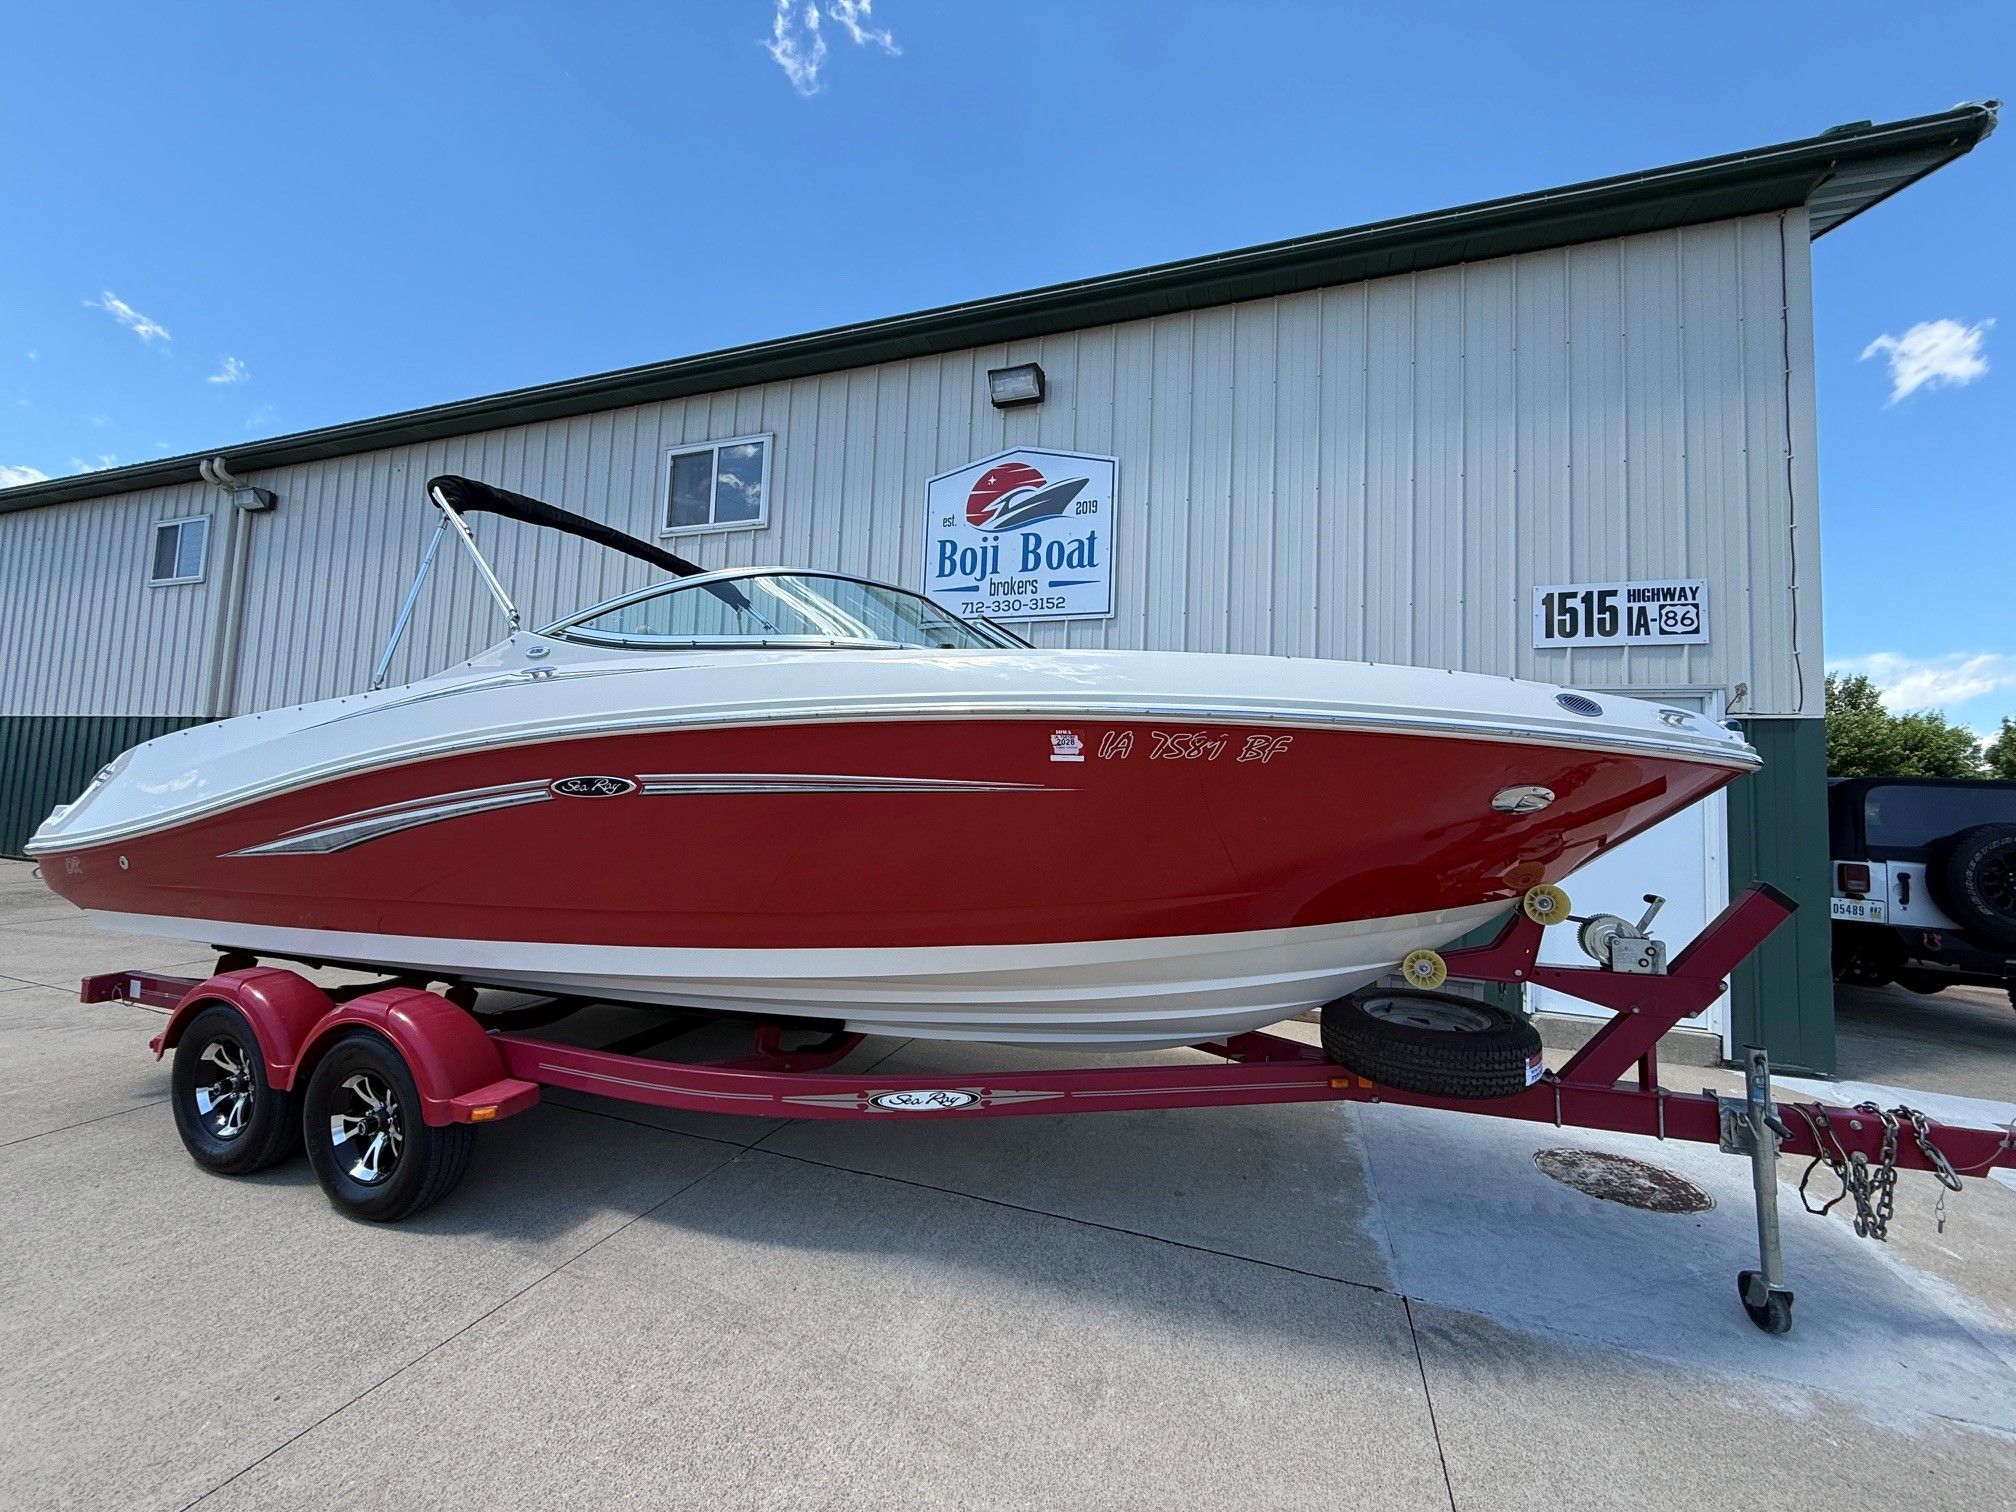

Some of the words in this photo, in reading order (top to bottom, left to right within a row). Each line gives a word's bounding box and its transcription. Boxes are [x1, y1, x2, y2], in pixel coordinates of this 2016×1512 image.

[1075, 499, 1098, 515] 2019
[942, 514, 957, 528] est.
[936, 535, 1000, 582] Boji
[1018, 530, 1100, 573] Boat
[989, 576, 1038, 597] brokers
[1626, 585, 1700, 603] HIGHWAY
[961, 596, 1066, 614] 712-330-3152
[1541, 589, 1619, 639] 1515
[1056, 738, 1076, 747] 2028
[1097, 730, 1134, 760] IA
[1236, 734, 1294, 763] BF
[561, 780, 588, 792] Sea
[591, 778, 621, 795] Ray
[1833, 903, 1865, 916] D5489
[888, 1093, 923, 1106] Sea
[925, 1091, 961, 1108] Ray
